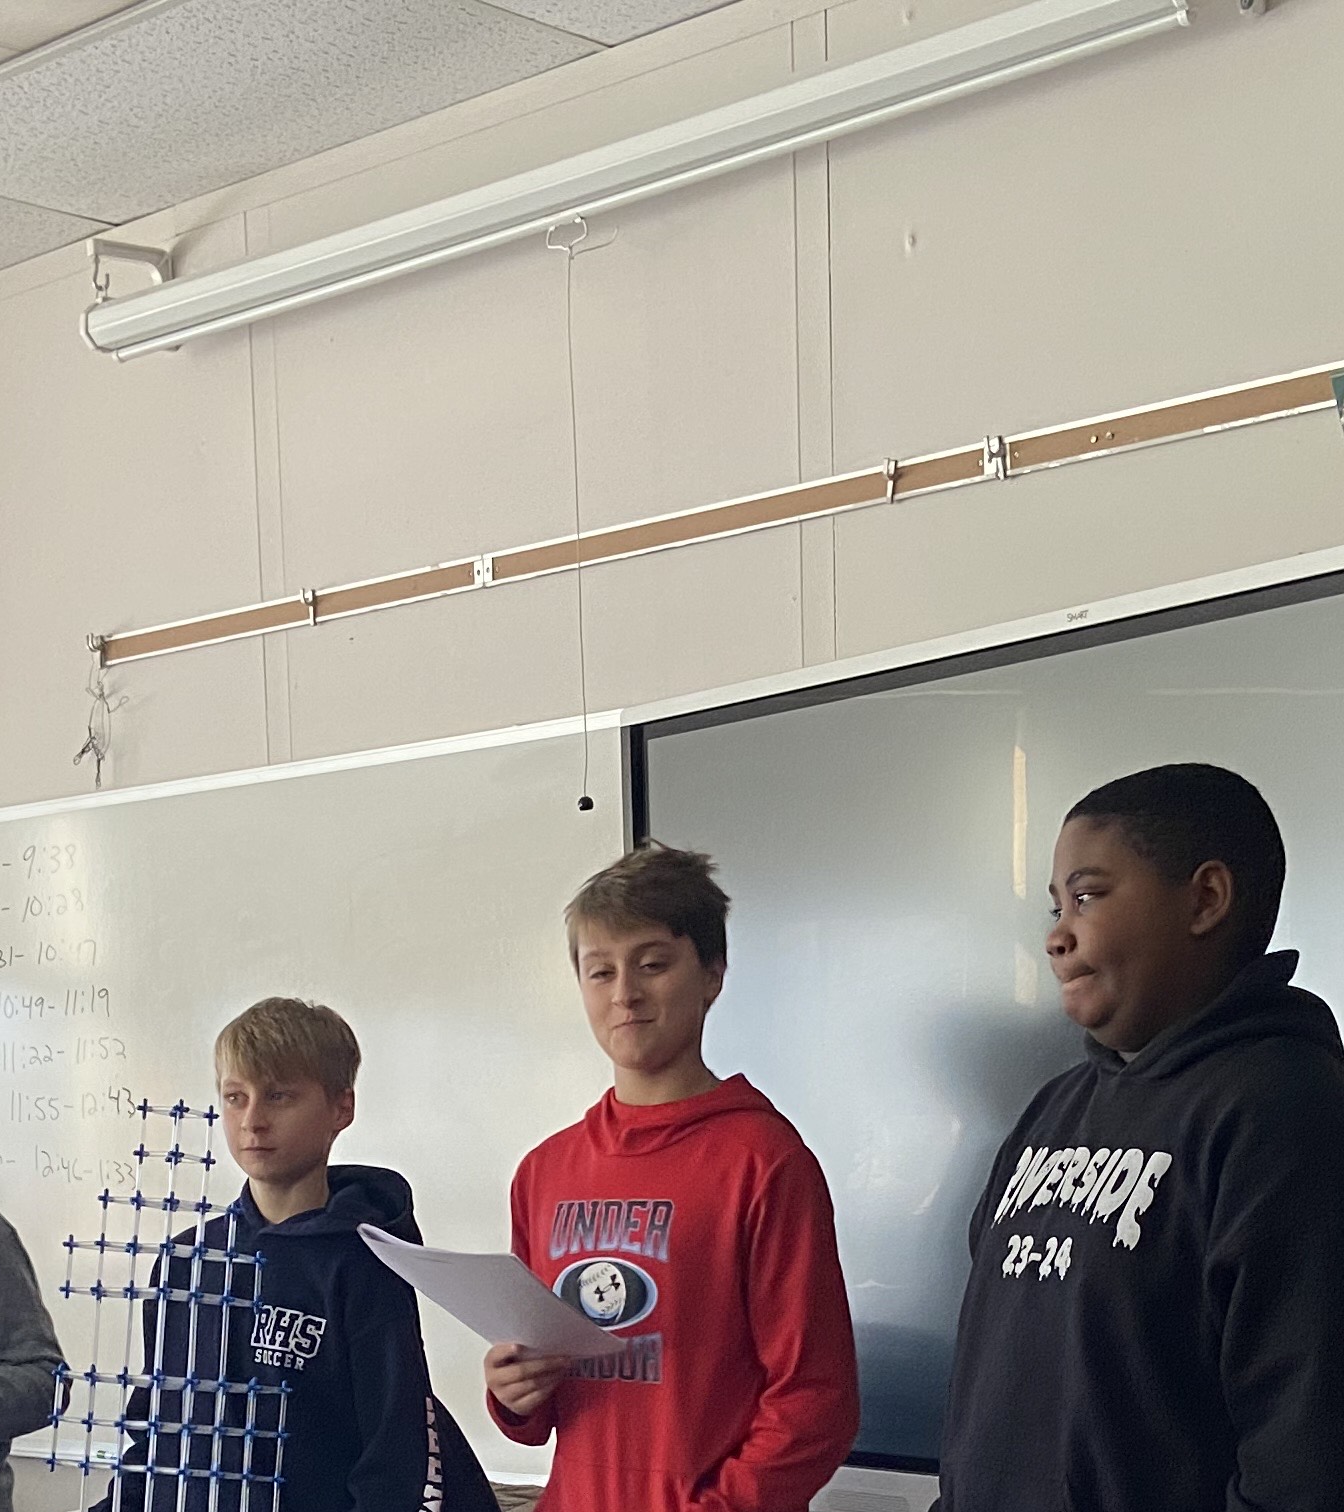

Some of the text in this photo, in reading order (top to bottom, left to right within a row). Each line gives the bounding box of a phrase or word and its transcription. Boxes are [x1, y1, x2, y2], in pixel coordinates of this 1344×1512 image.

[1067, 610, 1089, 623] SMART
[990, 1145, 1173, 1251] RIVERSIDE
[548, 1199, 675, 1264] UNDER
[1001, 1234, 1073, 1281] 23-24
[250, 1304, 327, 1359] RHS
[254, 1348, 306, 1372] SOCCER
